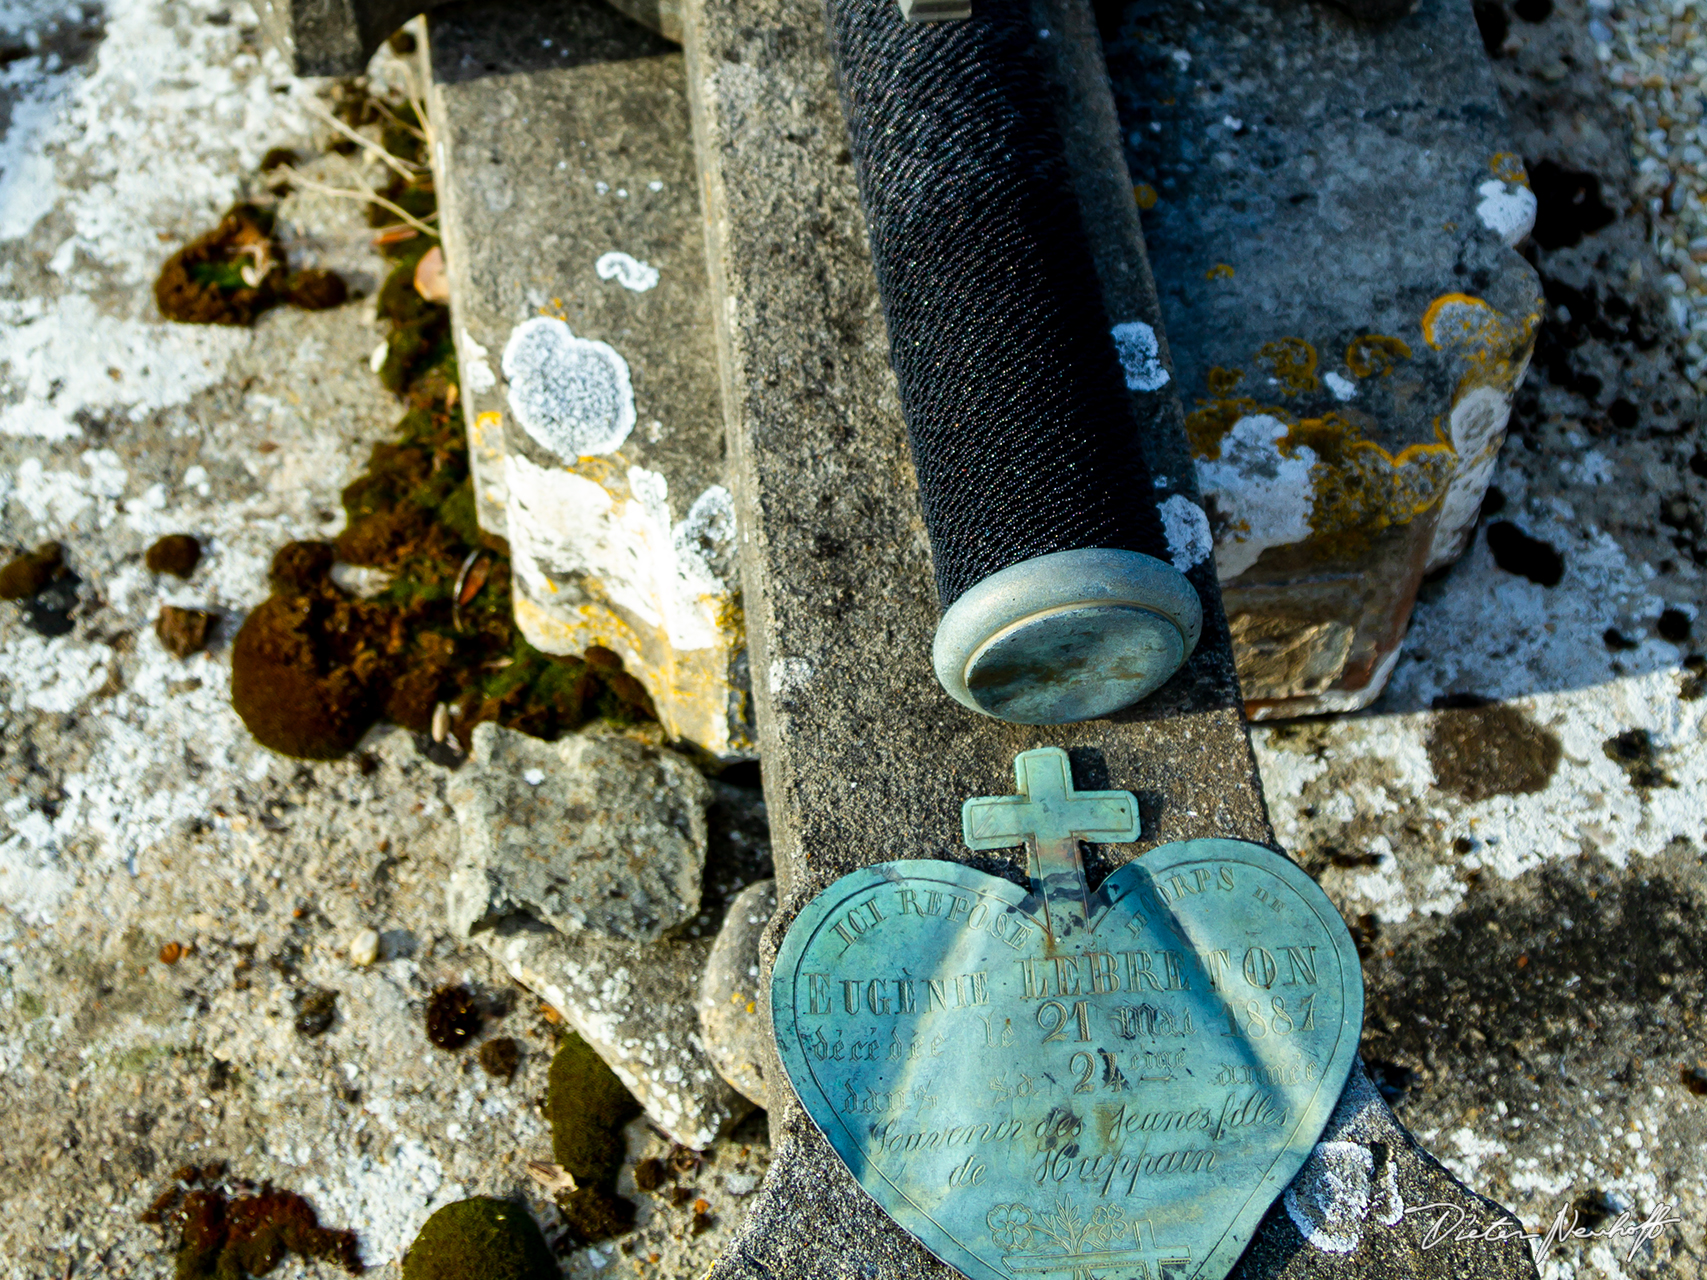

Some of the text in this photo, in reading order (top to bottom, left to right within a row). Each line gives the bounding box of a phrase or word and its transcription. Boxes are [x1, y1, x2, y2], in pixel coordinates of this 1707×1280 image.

[829, 889, 1034, 952] ICI REPOSE
[1140, 866, 1236, 916] CORPS
[1252, 884, 1286, 914] DE
[1014, 945, 1319, 1001] LEBRETON
[812, 1025, 946, 1062] décédée
[978, 1008, 1016, 1049] le
[1036, 1001, 1093, 1045] 21
[1219, 992, 1318, 1040] 1887
[841, 1078, 939, 1118] dans
[1213, 1053, 1319, 1087] année
[869, 1109, 1024, 1155] Souvenir
[1035, 1106, 1084, 1140] des
[1212, 1090, 1291, 1141] filles
[948, 1130, 1219, 1198] de Huppain
